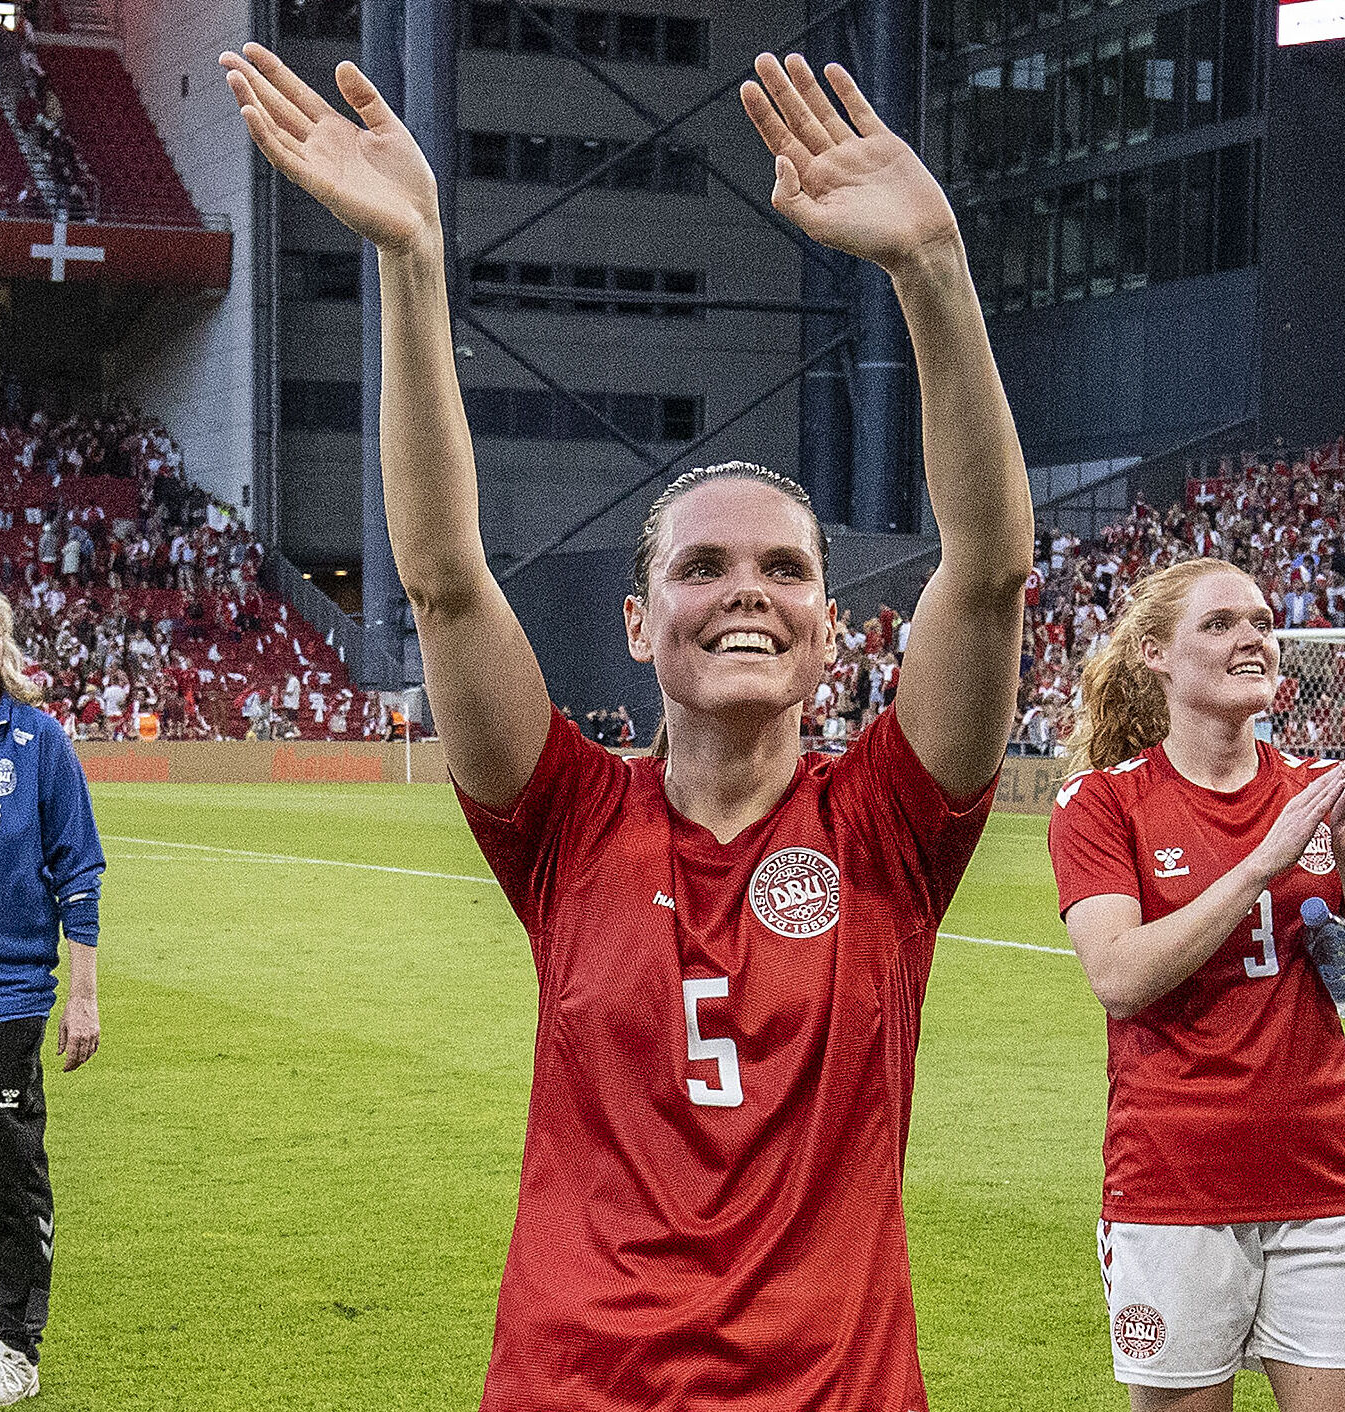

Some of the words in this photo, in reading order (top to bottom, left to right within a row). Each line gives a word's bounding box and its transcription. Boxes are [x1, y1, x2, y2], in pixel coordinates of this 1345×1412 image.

[769, 875, 826, 911] DBU
[1244, 890, 1280, 979] 3
[682, 977, 744, 1107] 5
[1124, 1322, 1156, 1341] DBU
